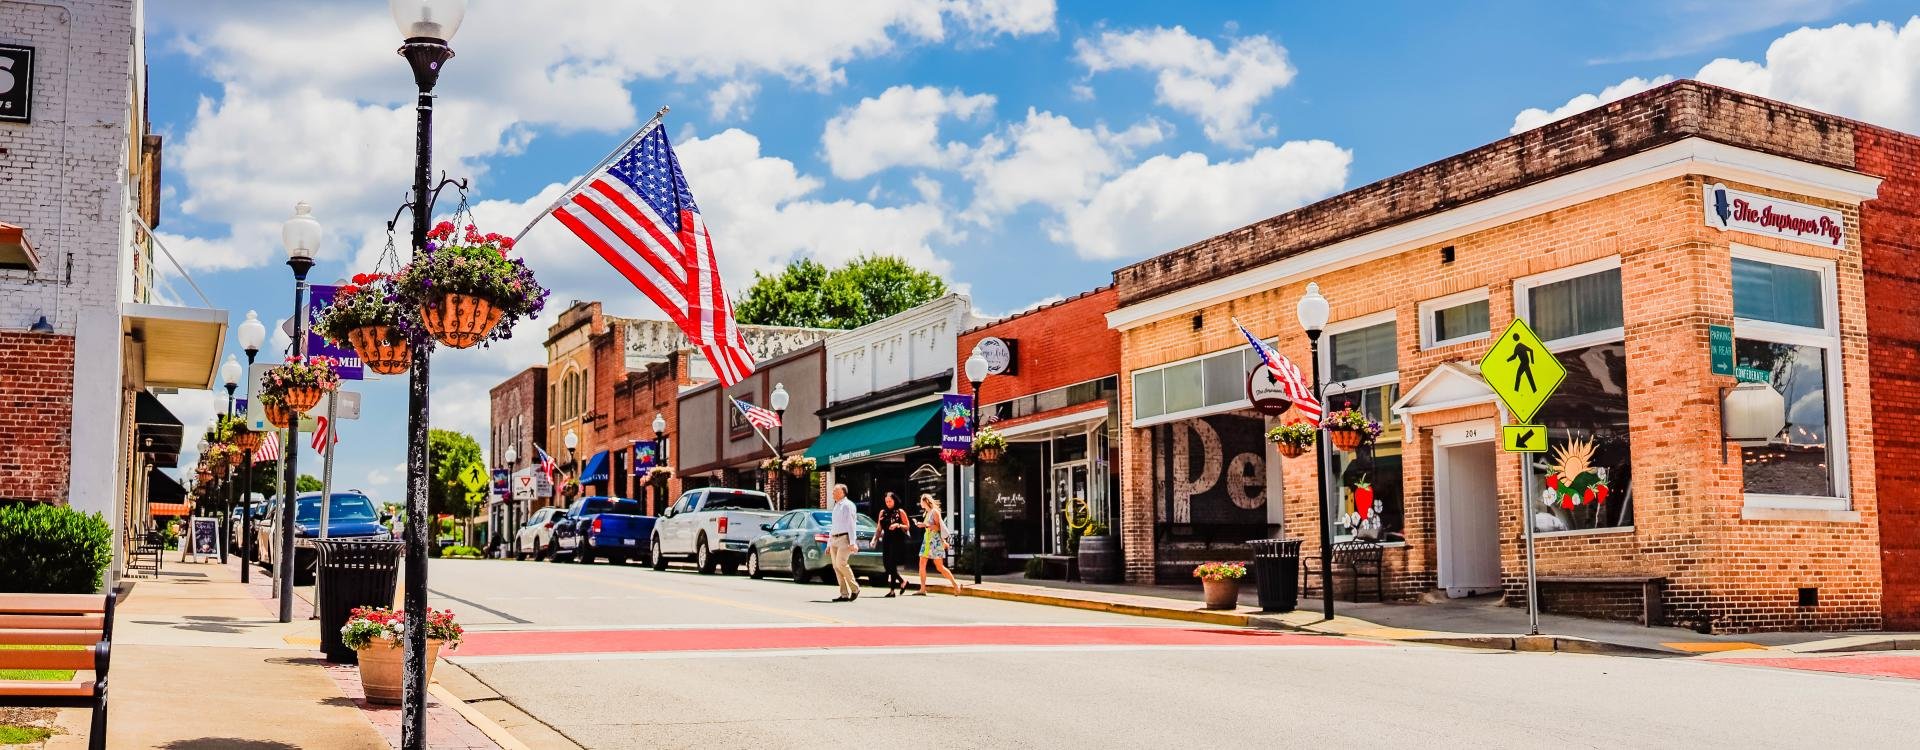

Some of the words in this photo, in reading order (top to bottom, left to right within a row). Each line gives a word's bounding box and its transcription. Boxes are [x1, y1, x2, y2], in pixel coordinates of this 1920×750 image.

[1734, 199, 1759, 223] The
[1760, 205, 1819, 236] Improper
[1820, 216, 1842, 245] Pig
[1711, 331, 1731, 341] PARKING
[1719, 345, 1731, 356] REAR
[339, 357, 361, 368] Mill
[1736, 367, 1764, 382] CONFEDERATE
[1466, 430, 1477, 438] 204
